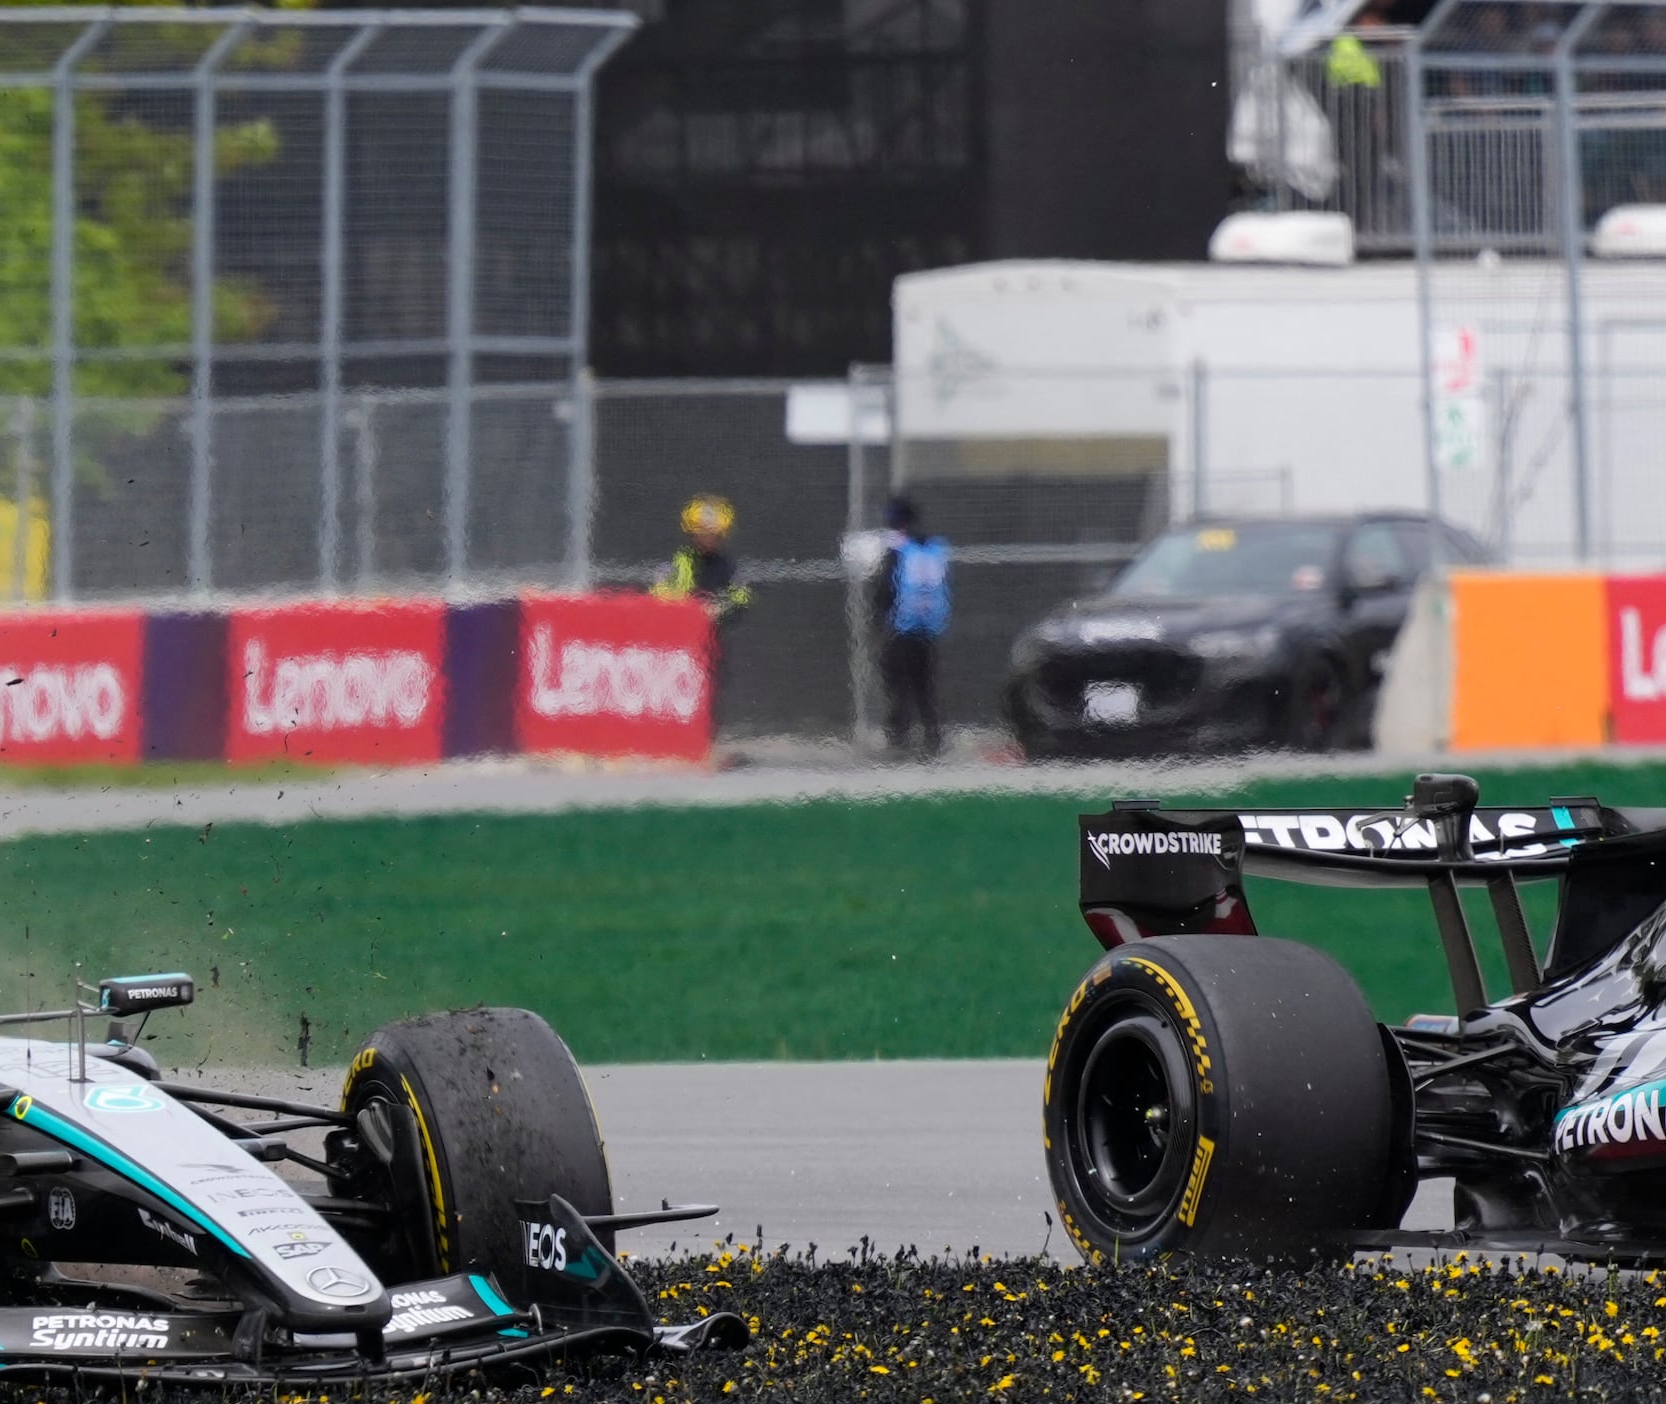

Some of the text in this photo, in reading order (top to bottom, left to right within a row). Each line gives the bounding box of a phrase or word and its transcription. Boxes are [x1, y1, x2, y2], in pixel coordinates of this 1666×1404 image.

[532, 624, 705, 724] Lenovo
[245, 639, 433, 734] Lenovo
[1098, 832, 1221, 855] CROWDSTRIKE
[127, 987, 178, 999] PETRONAS
[137, 1207, 197, 1256] Einhell
[276, 1243, 324, 1259] SAP
[32, 1315, 170, 1332] PETRONAS
[29, 1328, 169, 1350] Syntium
